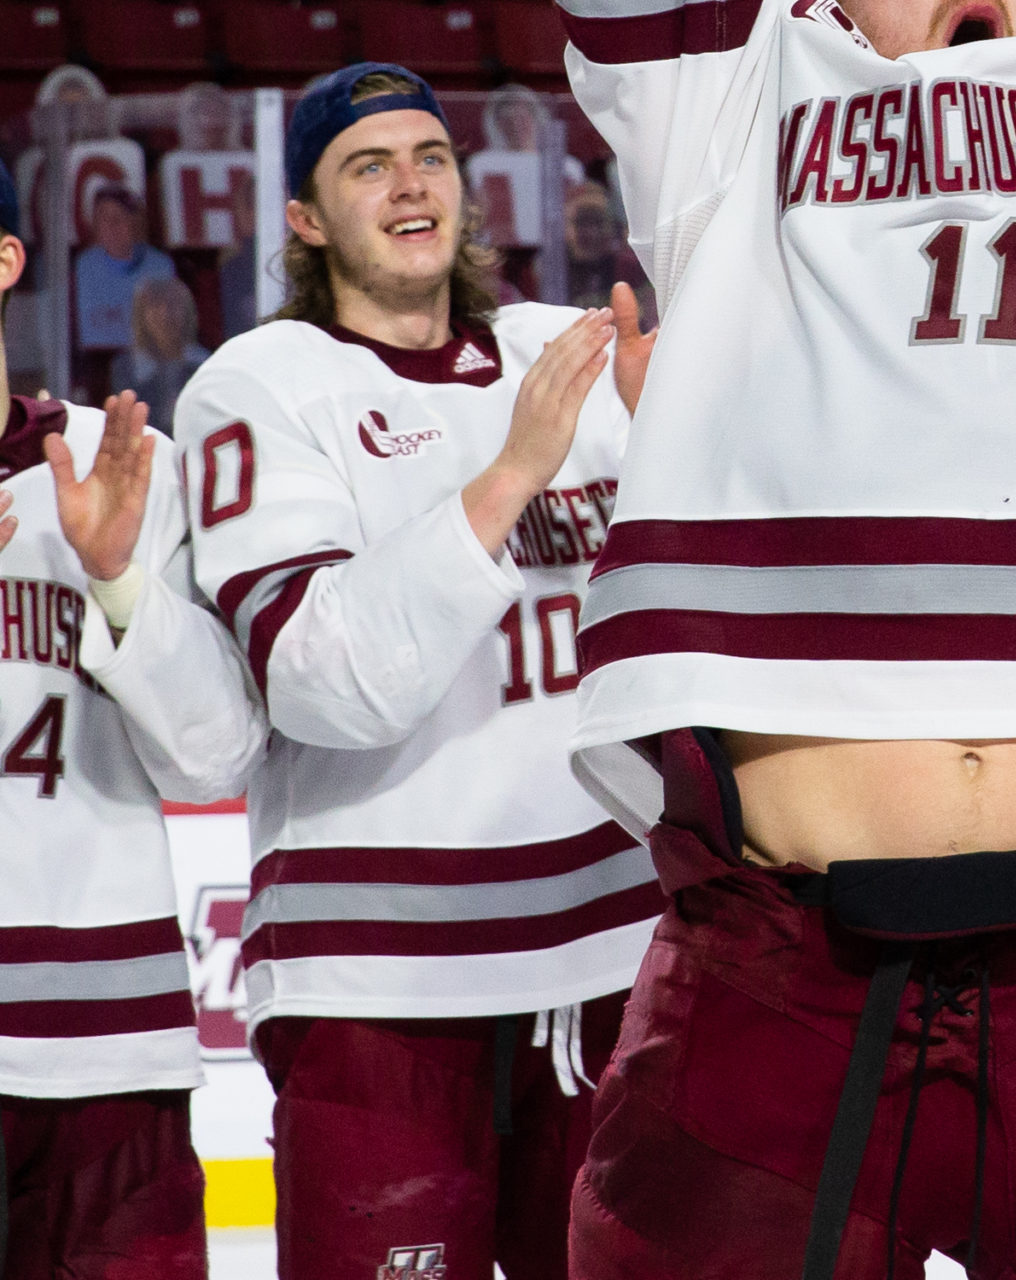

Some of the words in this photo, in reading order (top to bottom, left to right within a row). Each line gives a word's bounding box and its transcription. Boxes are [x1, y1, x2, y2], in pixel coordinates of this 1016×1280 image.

[453, 359, 496, 374] adidas
[494, 591, 582, 708] 10
[0, 693, 68, 800] 4
